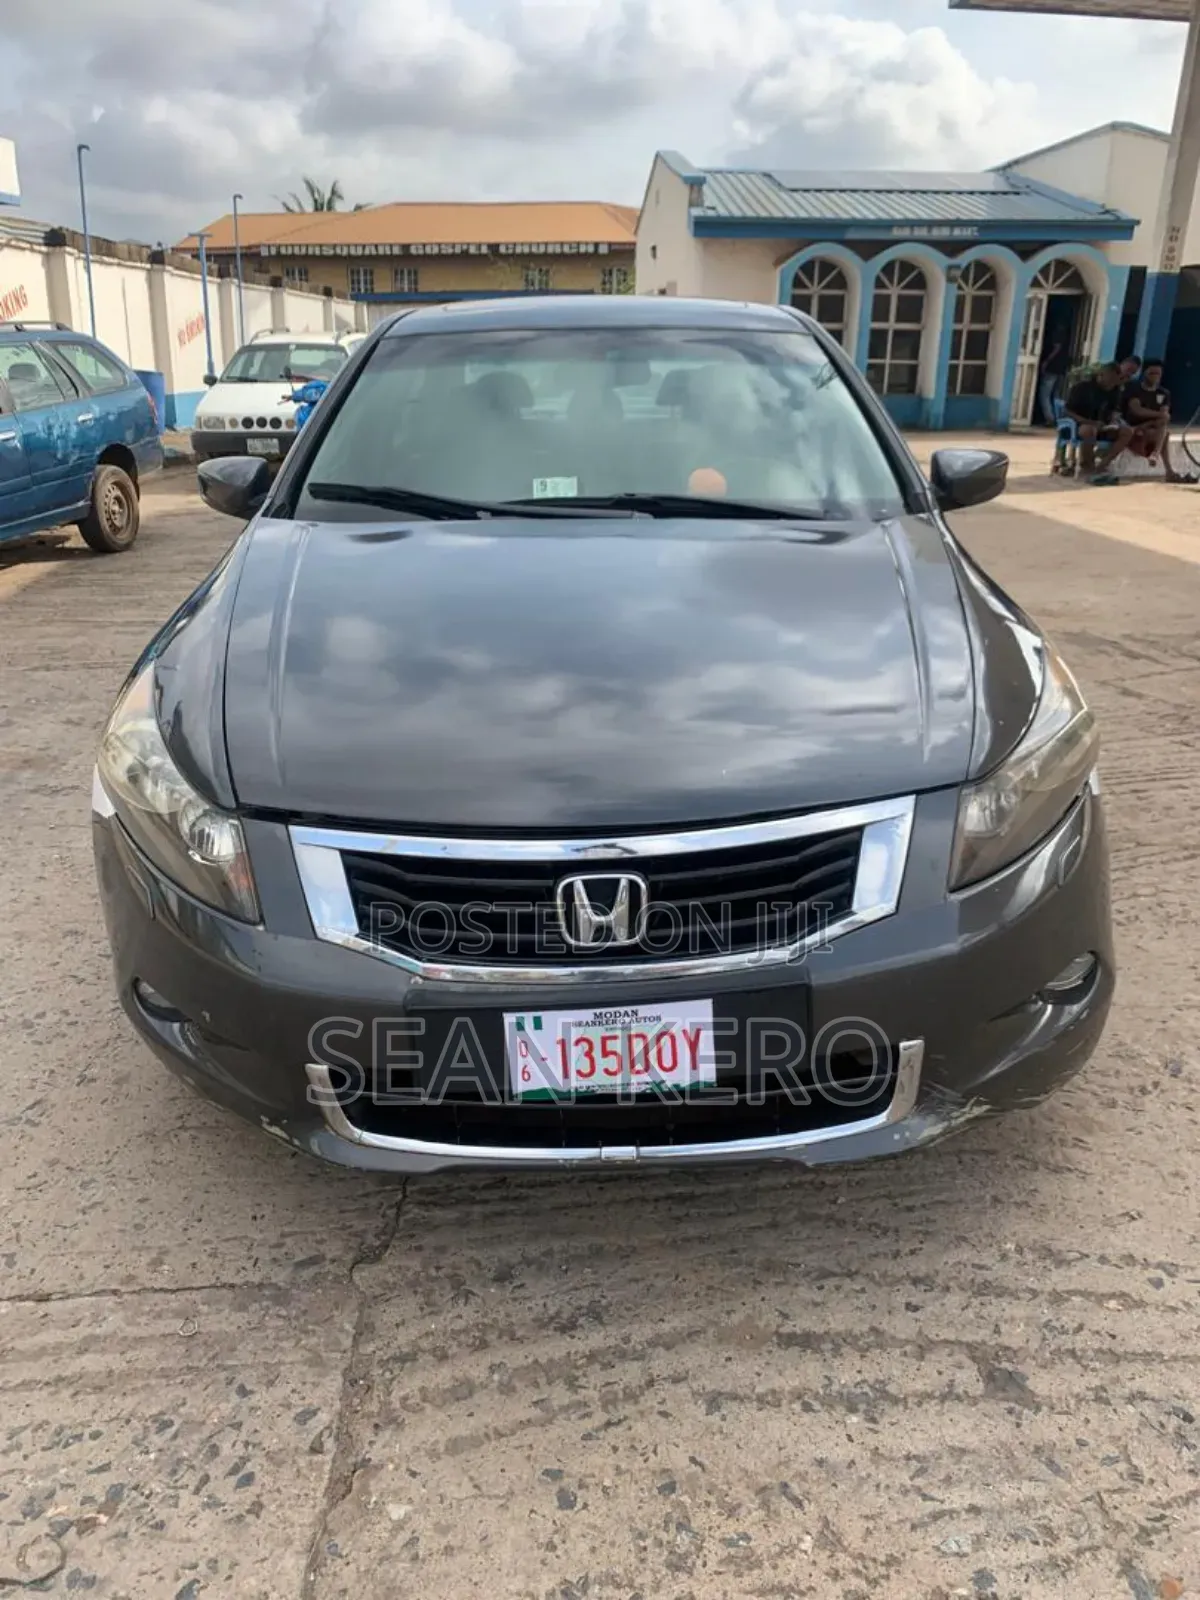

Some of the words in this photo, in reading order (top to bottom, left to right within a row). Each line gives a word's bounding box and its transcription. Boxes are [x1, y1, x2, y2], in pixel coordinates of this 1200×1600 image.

[409, 244, 488, 256] GOSPEL
[499, 243, 594, 255] CHURCH
[593, 1009, 639, 1020] MODAN
